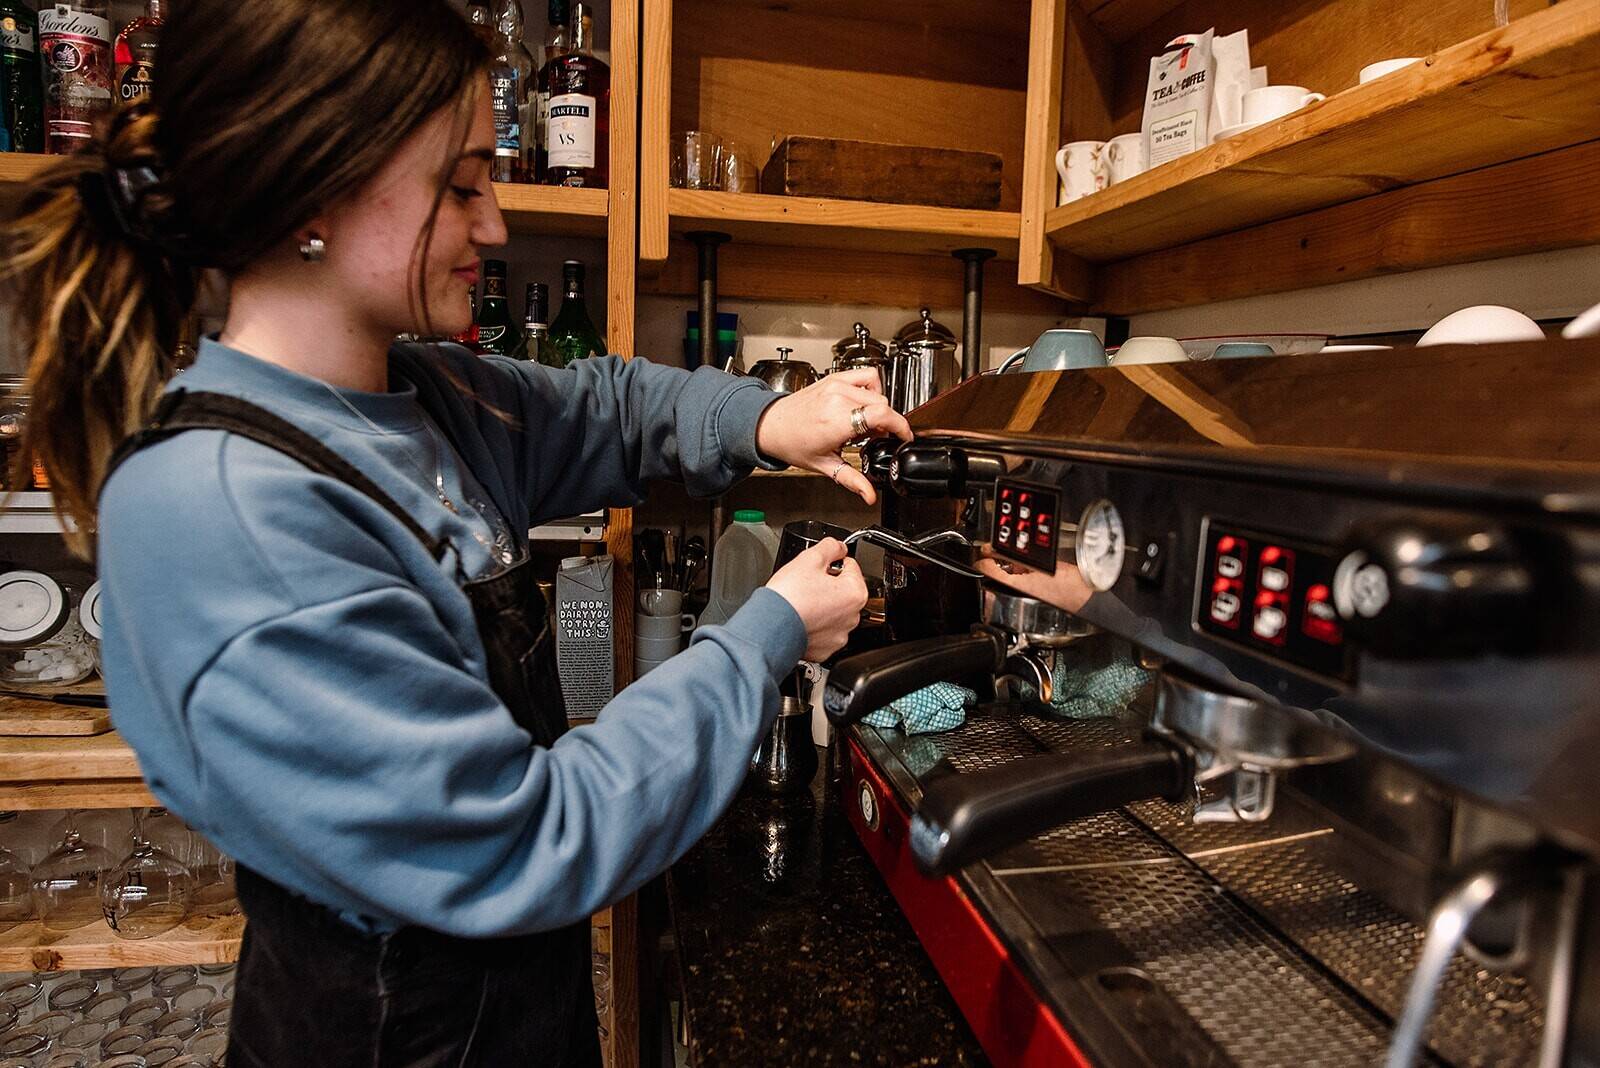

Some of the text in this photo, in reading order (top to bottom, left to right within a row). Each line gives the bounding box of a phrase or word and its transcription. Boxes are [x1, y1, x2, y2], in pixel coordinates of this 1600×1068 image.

[1152, 85, 1172, 101] TEA
[1181, 70, 1206, 90] COFFEE
[552, 106, 588, 116] MARTELL
[558, 133, 575, 145] VS
[561, 601, 609, 610] WE NON-
[560, 610, 610, 619] DAIRY YOU
[560, 619, 596, 629] TO TRY
[566, 629, 595, 638] THIS:
